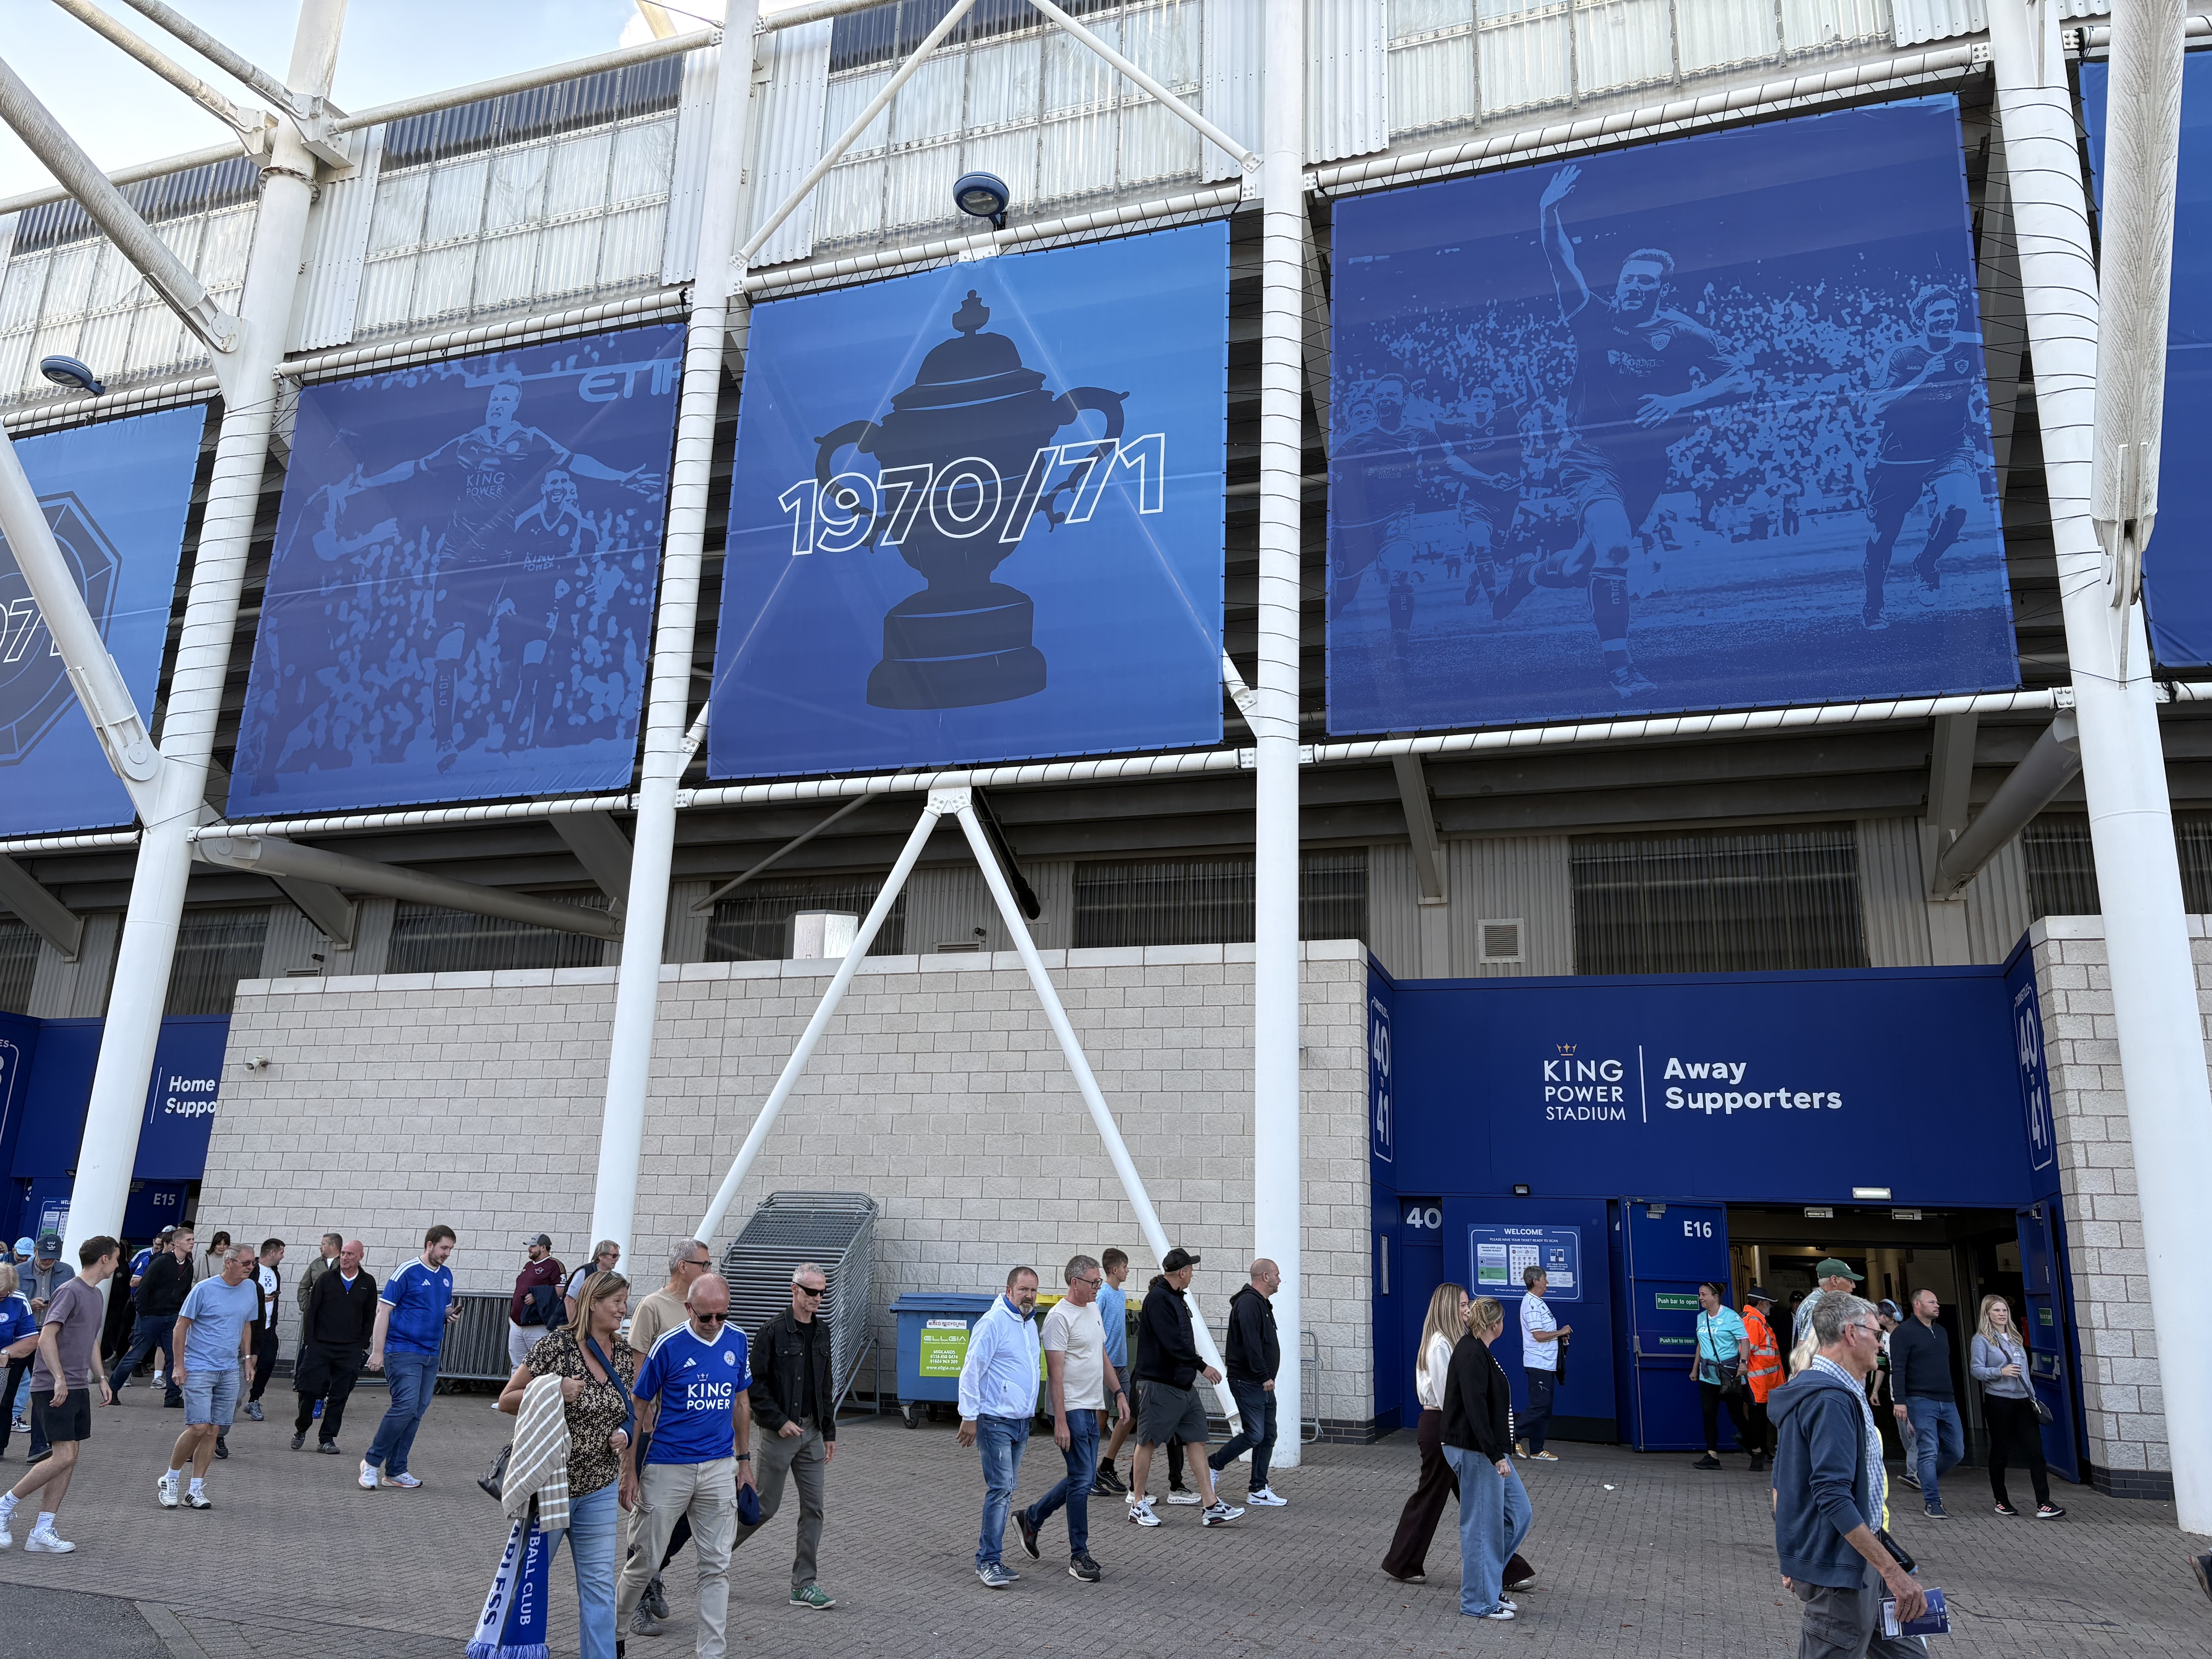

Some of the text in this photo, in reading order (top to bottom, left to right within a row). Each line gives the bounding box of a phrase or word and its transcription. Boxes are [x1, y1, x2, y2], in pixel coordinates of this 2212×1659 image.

[1613, 326, 1629, 335] JAKO
[467, 472, 505, 486] KING
[778, 433, 1165, 556] 1970/71
[1374, 1019, 1389, 1077] 40
[2020, 1007, 2037, 1073] 40
[1544, 1059, 1623, 1082] KING
[1664, 1057, 1747, 1085] Away
[168, 1076, 216, 1092] Home
[1545, 1086, 1624, 1102] POWER
[1665, 1087, 1843, 1115] Supporters
[1377, 1090, 1389, 1146] 41
[1546, 1106, 1626, 1121] STADIUM
[2031, 1086, 2047, 1150] 41
[153, 1193, 176, 1206] E15
[1407, 1207, 1442, 1229] 40
[1683, 1221, 1712, 1238] E16
[688, 1382, 732, 1398] KING
[687, 1399, 730, 1410] POWER
[520, 1582, 533, 1625] CLUB
